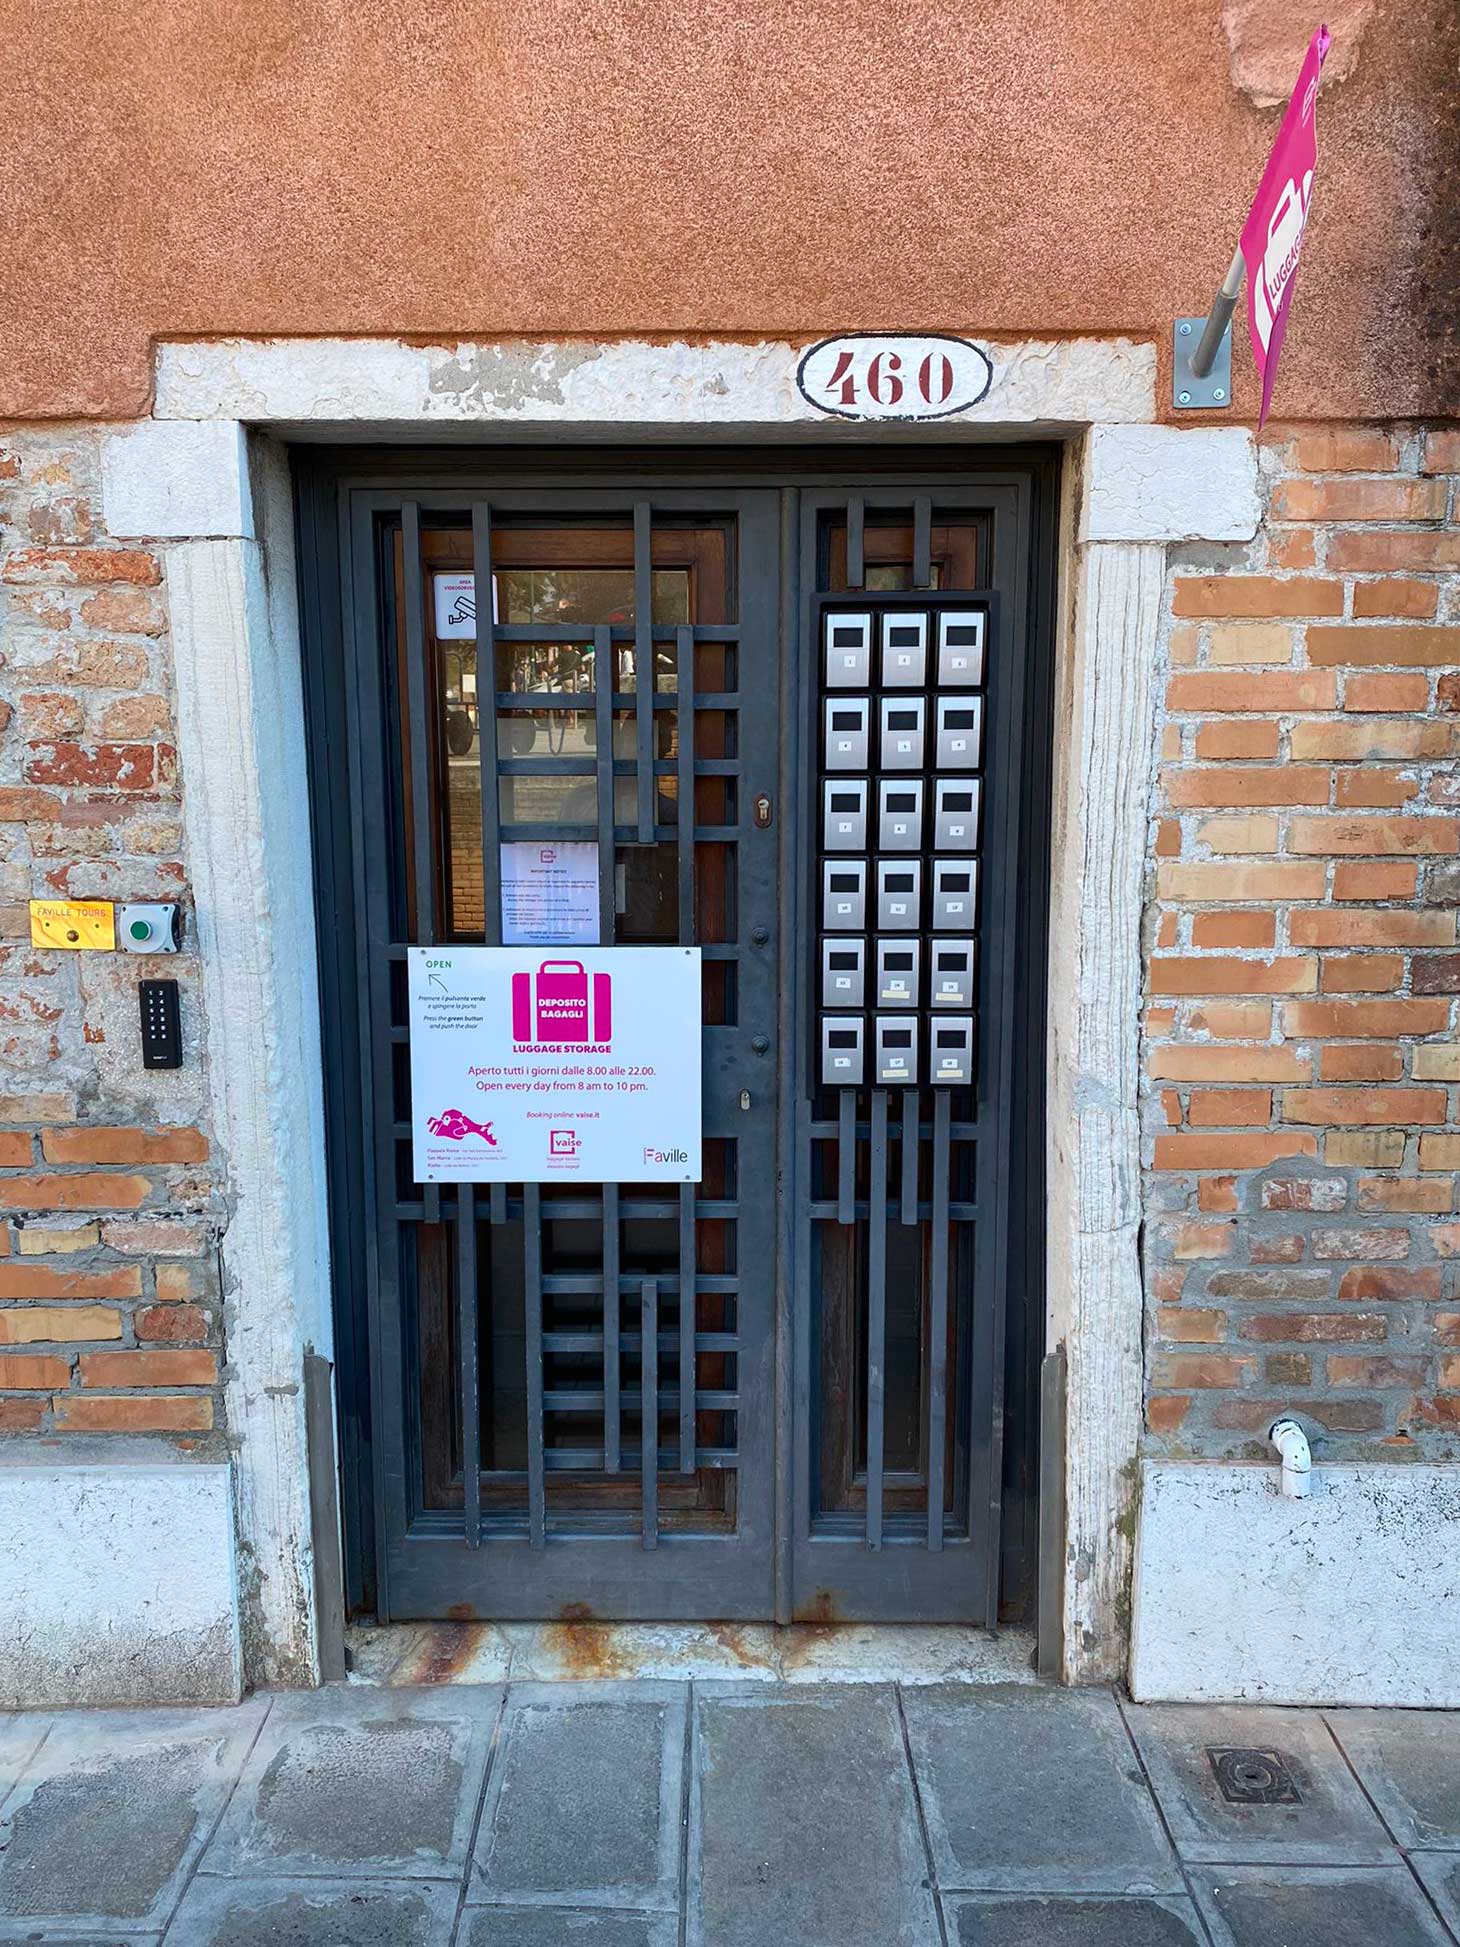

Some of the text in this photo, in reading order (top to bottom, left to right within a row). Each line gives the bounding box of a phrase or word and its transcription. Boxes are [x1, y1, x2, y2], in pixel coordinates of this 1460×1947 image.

[825, 352, 954, 405] 460
[37, 908, 106, 918] FAVILLE TOURS
[425, 960, 452, 968] OPEN
[538, 999, 587, 1007] DEPOSITO
[540, 1010, 584, 1018] BAGAGLI
[513, 1045, 611, 1053] LUGGAGE STORAGE
[468, 1066, 501, 1078] Aperto
[503, 1066, 525, 1076] tutti
[531, 1066, 560, 1078] giorni
[561, 1066, 585, 1076] dalle
[586, 1066, 607, 1076] 8.00
[609, 1066, 626, 1076] alle
[628, 1066, 656, 1076] 22.00.
[476, 1081, 648, 1092] Open every day from 8 am to 10 pm.
[526, 1111, 553, 1119] Booking
[576, 1111, 600, 1119] vaise.it
[555, 1138, 582, 1147] vaise
[643, 1147, 688, 1164] Faville
